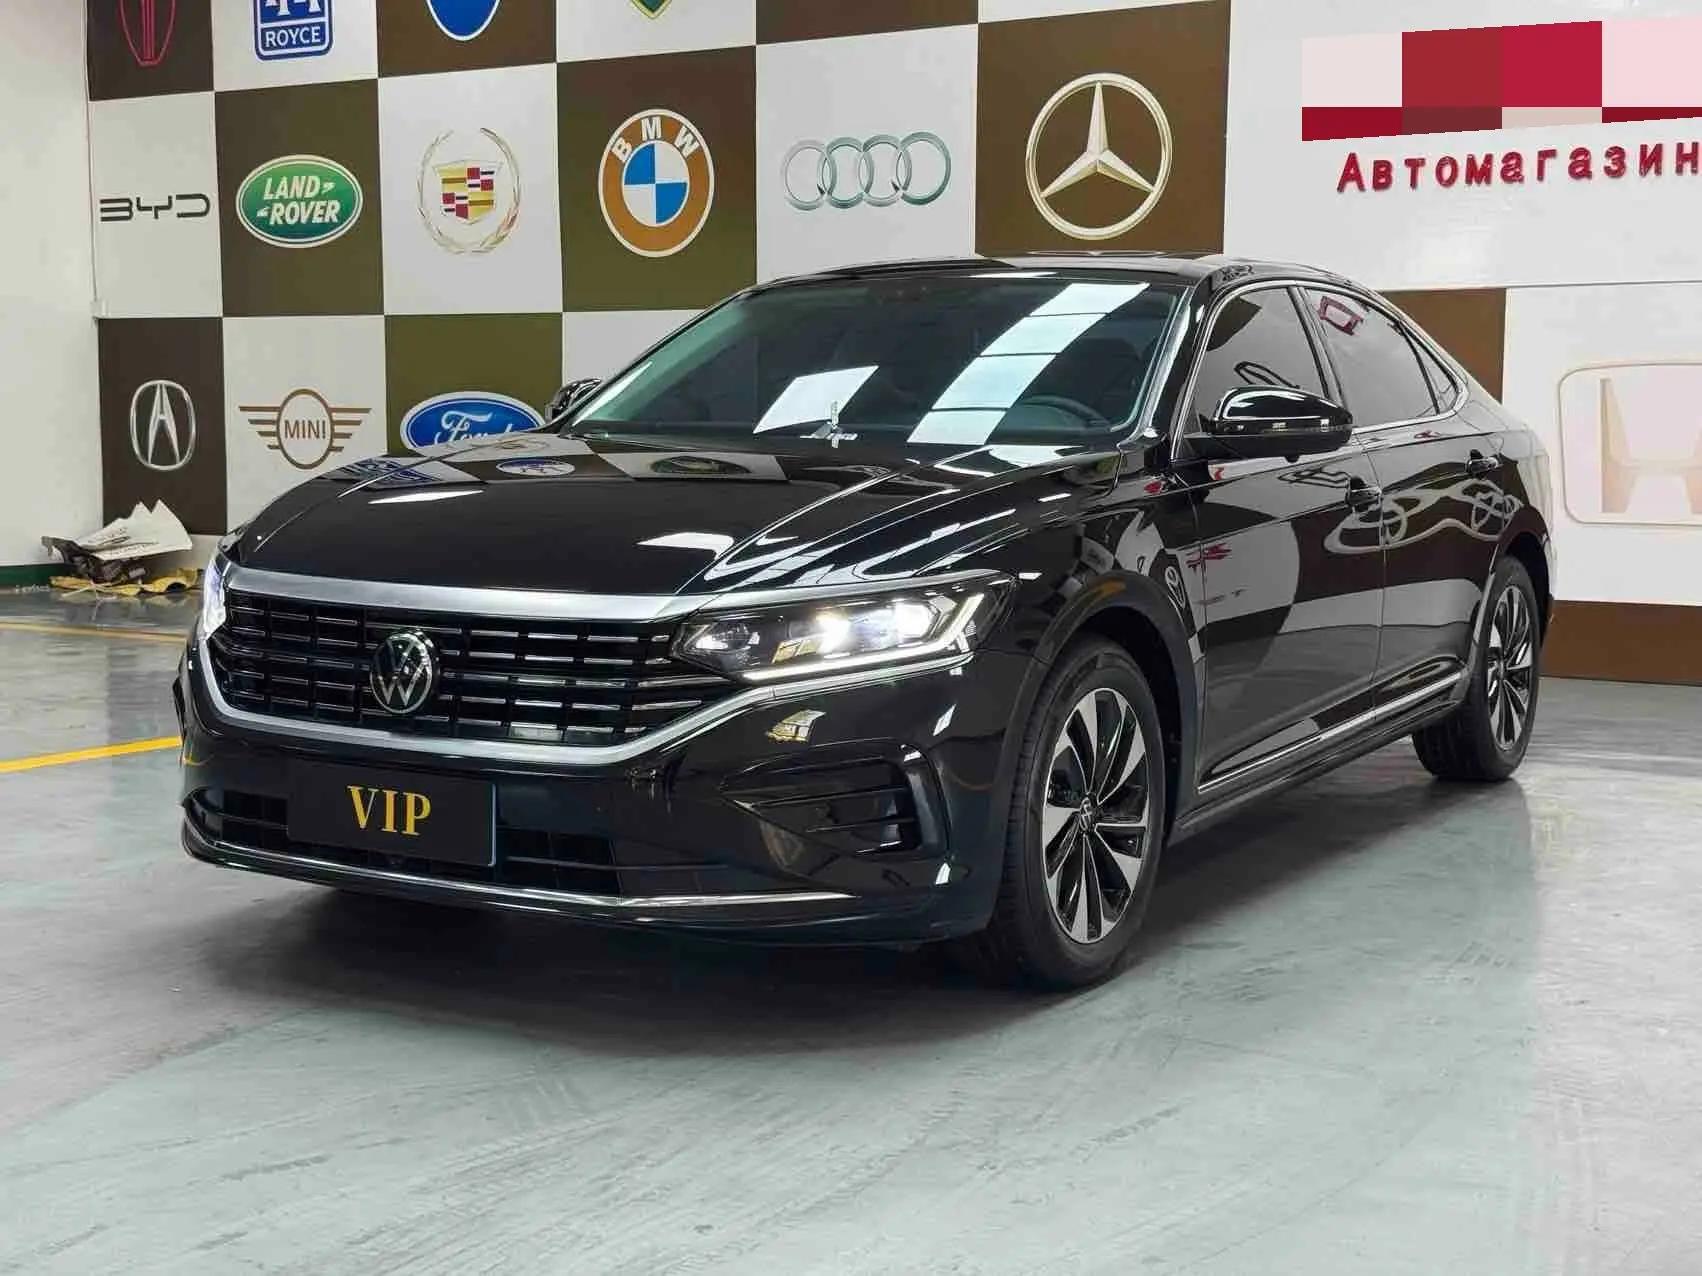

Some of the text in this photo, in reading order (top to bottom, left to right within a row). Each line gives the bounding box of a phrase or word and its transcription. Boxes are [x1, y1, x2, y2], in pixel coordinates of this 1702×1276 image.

[265, 26, 321, 48] ROYCE
[611, 116, 700, 163] BMW
[1336, 141, 1702, 193] Автомагазин
[264, 175, 321, 200] LAND
[99, 193, 211, 222] BYD
[269, 199, 341, 225] ROVER
[284, 419, 326, 439] MINI
[347, 785, 431, 836] VIP
